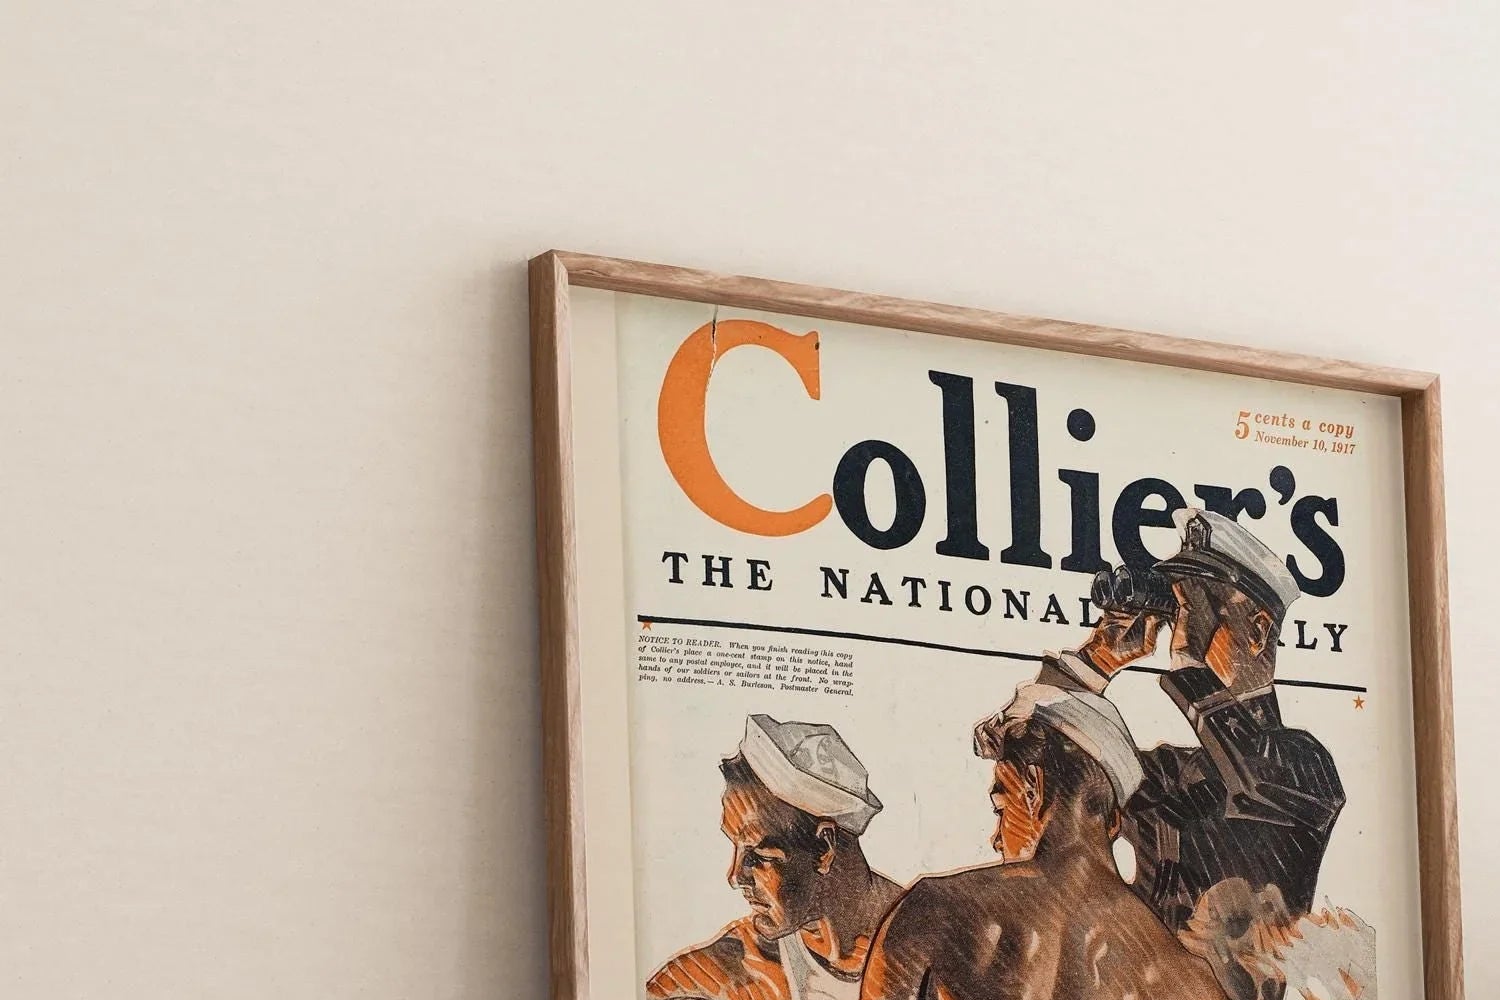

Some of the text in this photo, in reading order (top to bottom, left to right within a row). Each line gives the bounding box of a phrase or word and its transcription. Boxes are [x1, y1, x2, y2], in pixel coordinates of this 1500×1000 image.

[1234, 410, 1355, 440] 5 cents a copy
[1253, 430, 1357, 455] November 10, 1917
[661, 551, 773, 592] THE
[820, 566, 1103, 628] NATIONAL
[638, 636, 670, 644] NOTICE
[729, 642, 749, 650] When
[767, 645, 788, 653] finish
[791, 648, 818, 656] reading
[638, 645, 646, 653] of
[684, 649, 702, 657] place
[750, 654, 772, 662] stamp
[790, 656, 803, 664] this
[835, 660, 853, 668] hand
[638, 664, 660, 672] hands
[693, 667, 720, 675] soldiers
[686, 658, 708, 666] postal
[793, 665, 801, 673] be
[805, 667, 828, 675] placed
[780, 683, 818, 692] Postmaster
